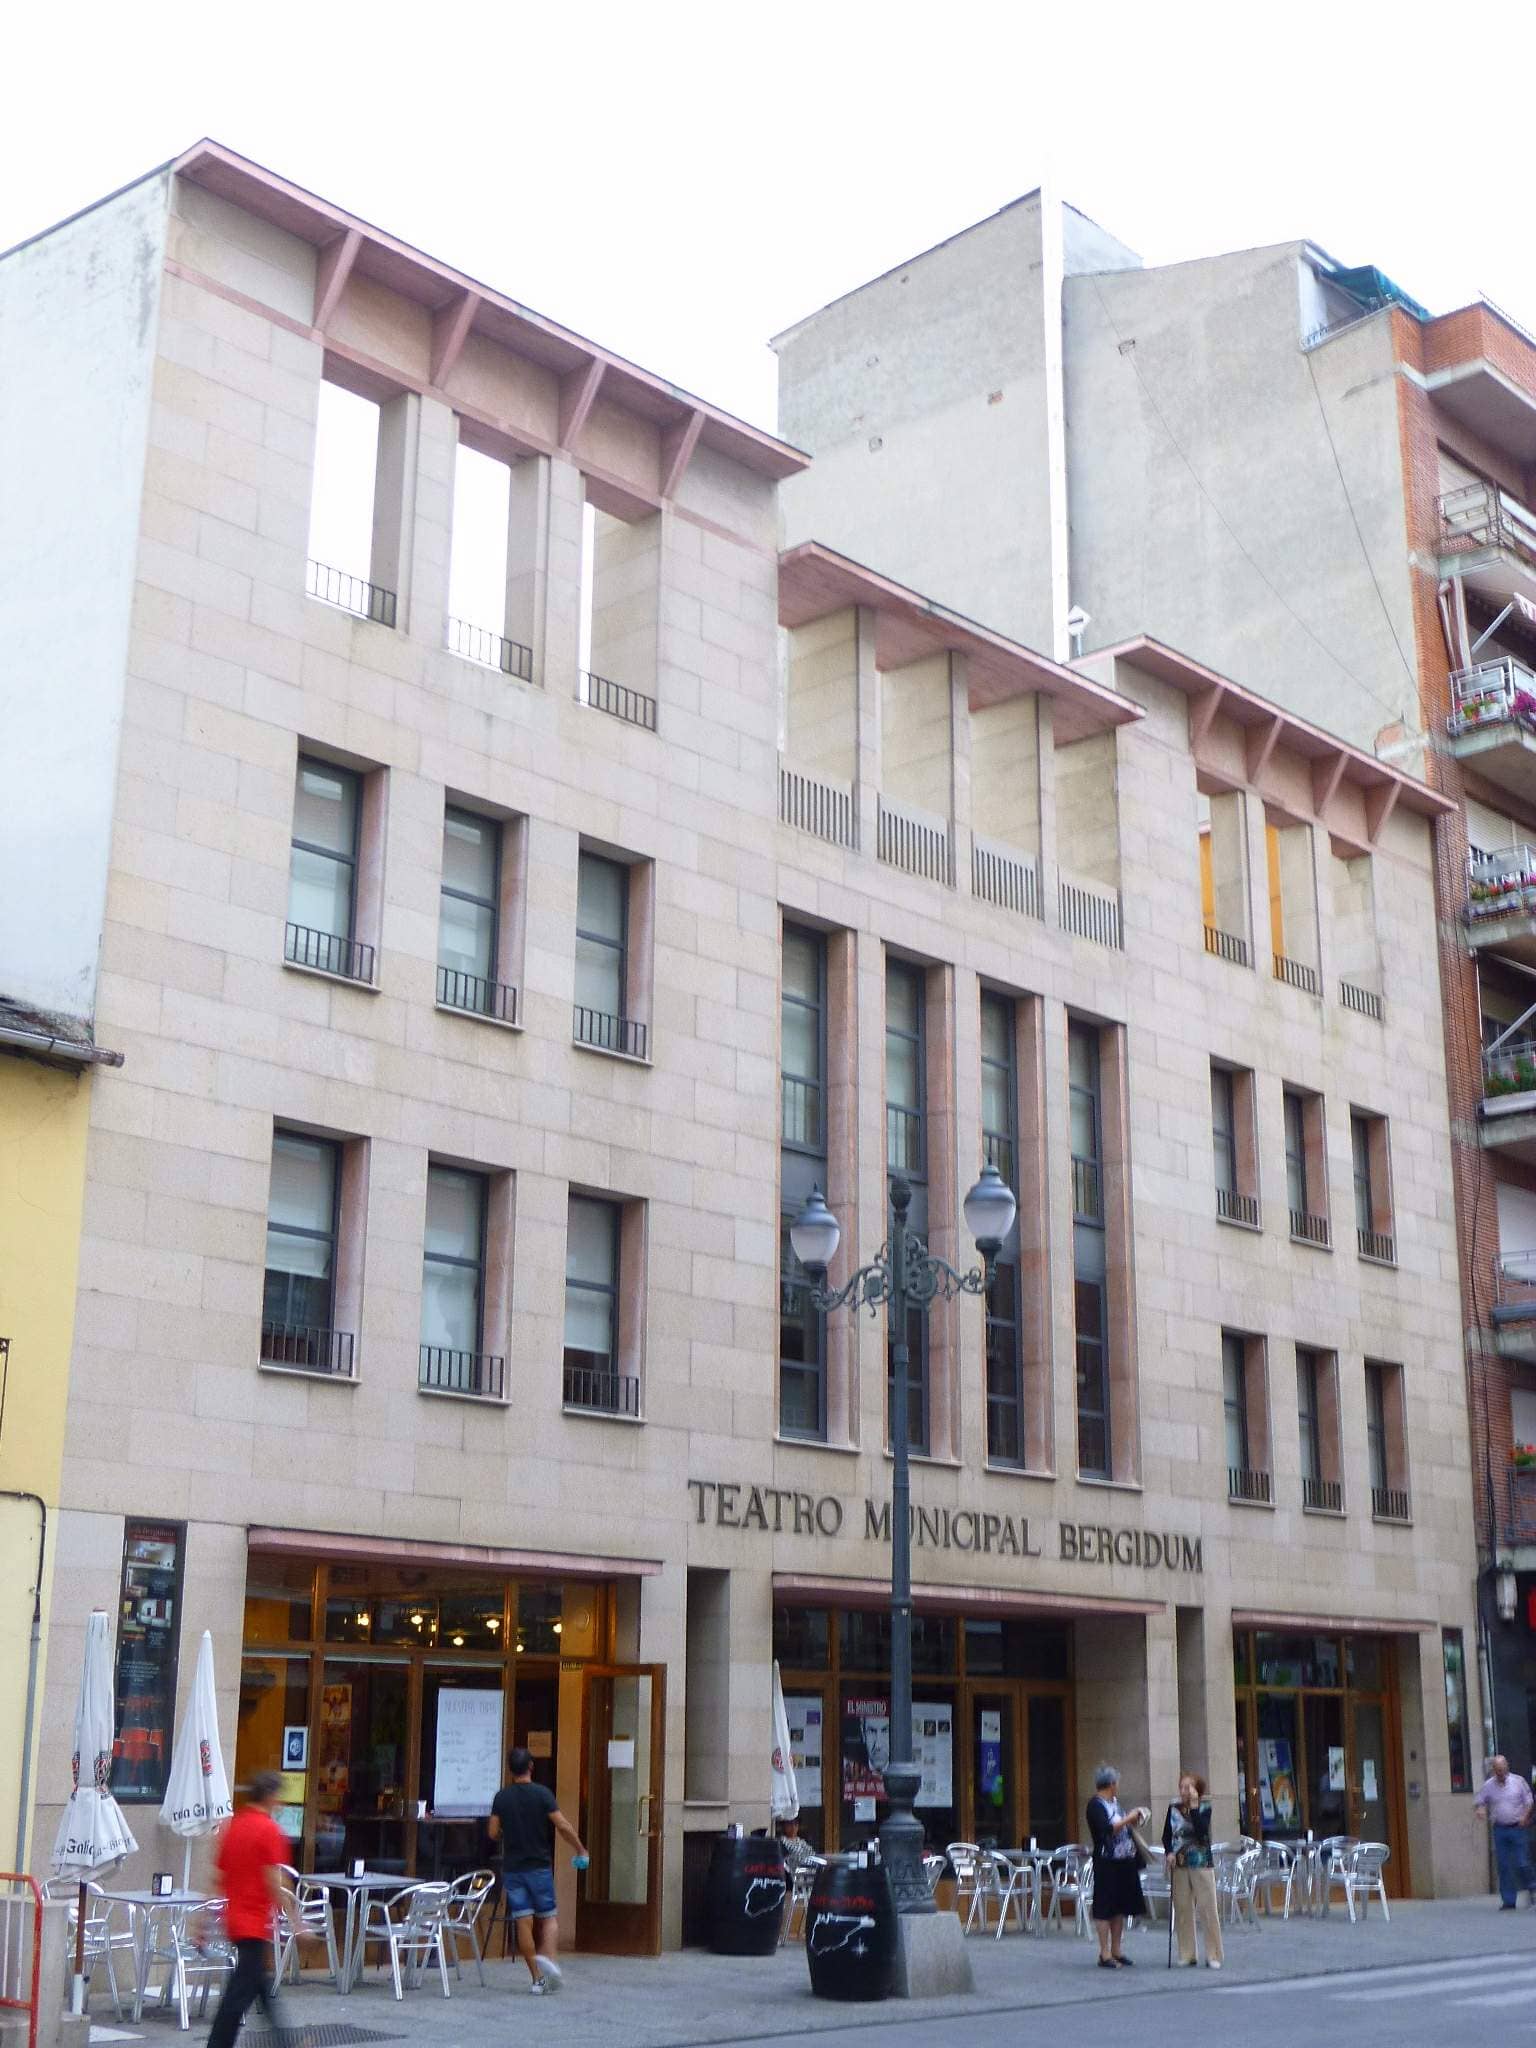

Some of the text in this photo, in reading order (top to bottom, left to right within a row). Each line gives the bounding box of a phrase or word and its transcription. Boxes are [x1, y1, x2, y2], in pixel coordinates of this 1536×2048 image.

[688, 1479, 1203, 1573] TEATRO MNICIPAL BERGIDUM
